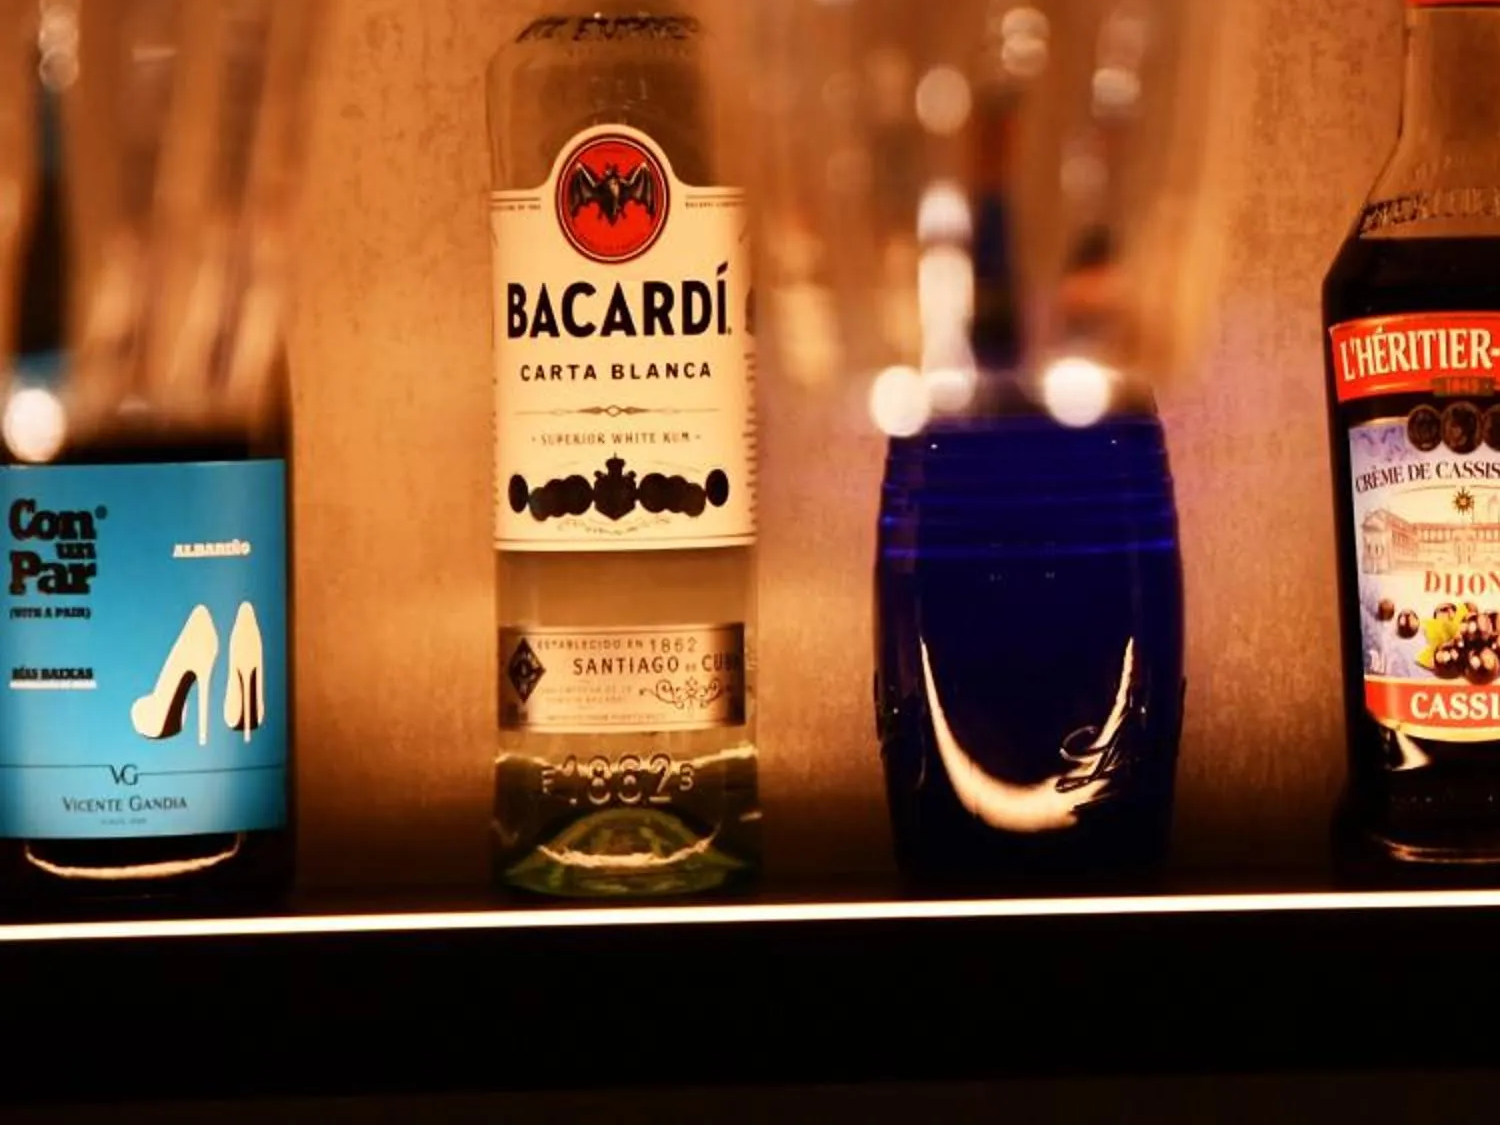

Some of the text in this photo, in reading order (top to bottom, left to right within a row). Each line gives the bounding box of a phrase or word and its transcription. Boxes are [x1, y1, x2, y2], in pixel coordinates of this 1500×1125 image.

[507, 261, 730, 339] BACARDÍ
[519, 361, 712, 382] CARTA BLANCA
[541, 432, 690, 446] SUPERIOR WHITE RUM
[1355, 464, 1406, 494] CRÈME
[1407, 462, 1432, 481] DE
[9, 499, 97, 541] Con
[56, 542, 96, 560] un
[9, 550, 97, 595] Par
[43, 606, 53, 619] A
[537, 636, 699, 653] ESTABLECIDO EN 1862
[572, 656, 680, 676] SANTIAGO
[62, 795, 123, 813] VICENTE
